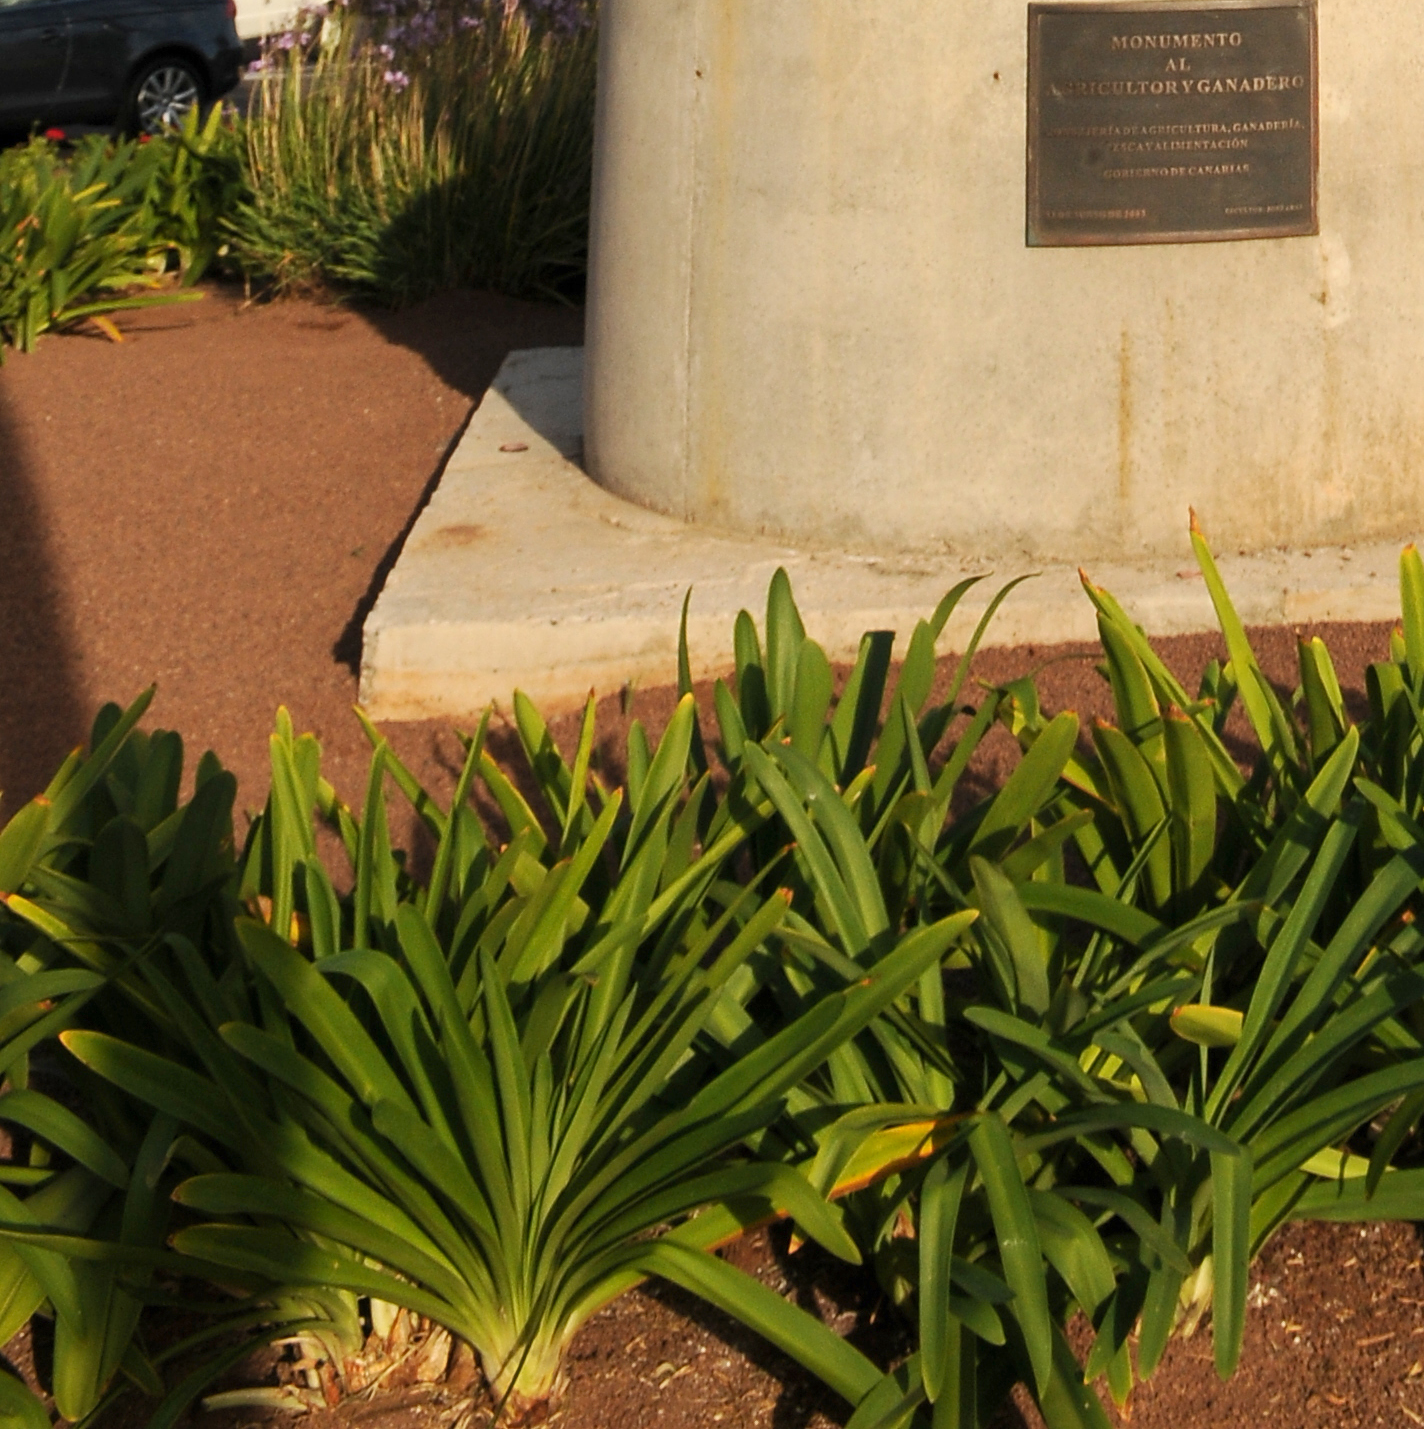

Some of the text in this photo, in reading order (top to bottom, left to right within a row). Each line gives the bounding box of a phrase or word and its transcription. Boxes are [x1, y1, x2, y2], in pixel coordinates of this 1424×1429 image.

[1111, 32, 1242, 49] MONUMENTO
[1165, 57, 1191, 72] AL
[1182, 79, 1195, 94] Y
[1197, 74, 1304, 93] GANADERO
